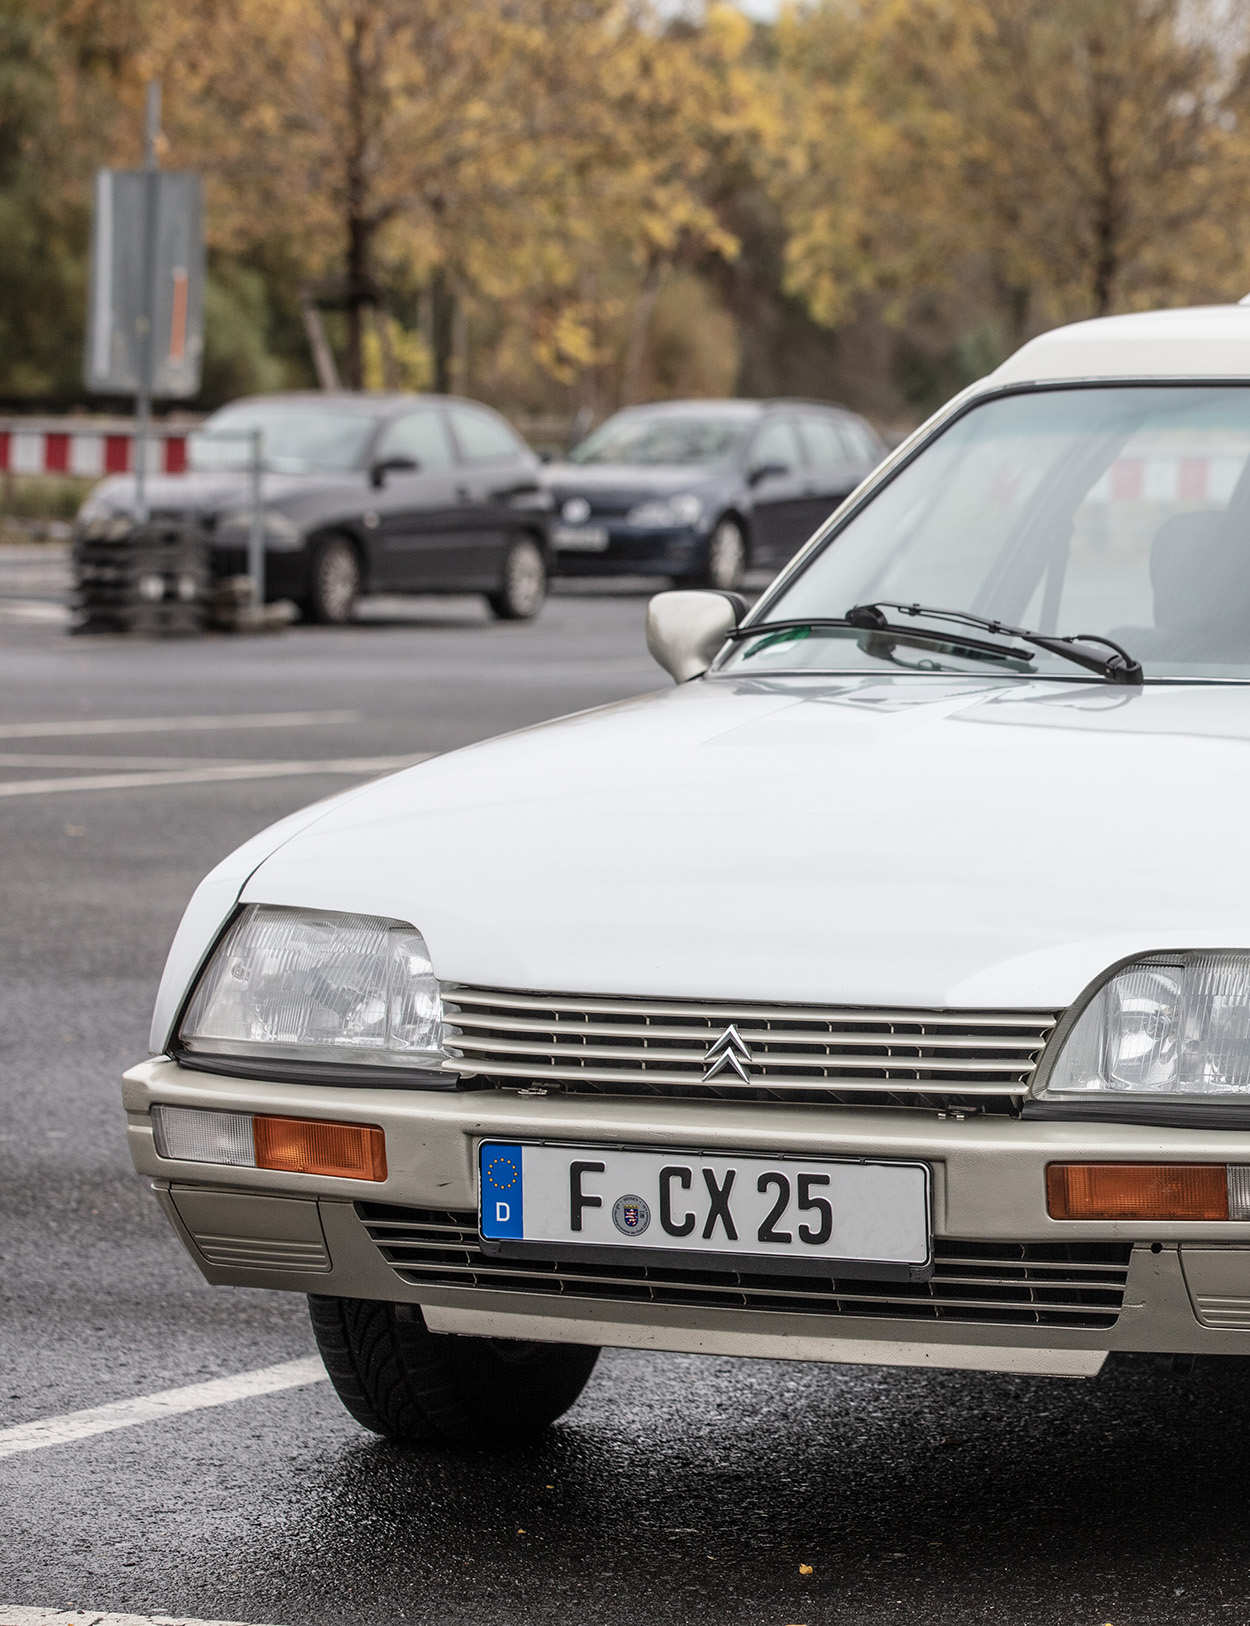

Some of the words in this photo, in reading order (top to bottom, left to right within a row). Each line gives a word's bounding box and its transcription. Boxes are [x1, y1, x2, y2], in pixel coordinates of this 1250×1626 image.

[495, 1202, 511, 1222] D
[570, 1160, 606, 1232] F
[659, 1165, 739, 1241] CX
[757, 1172, 833, 1245] 25
